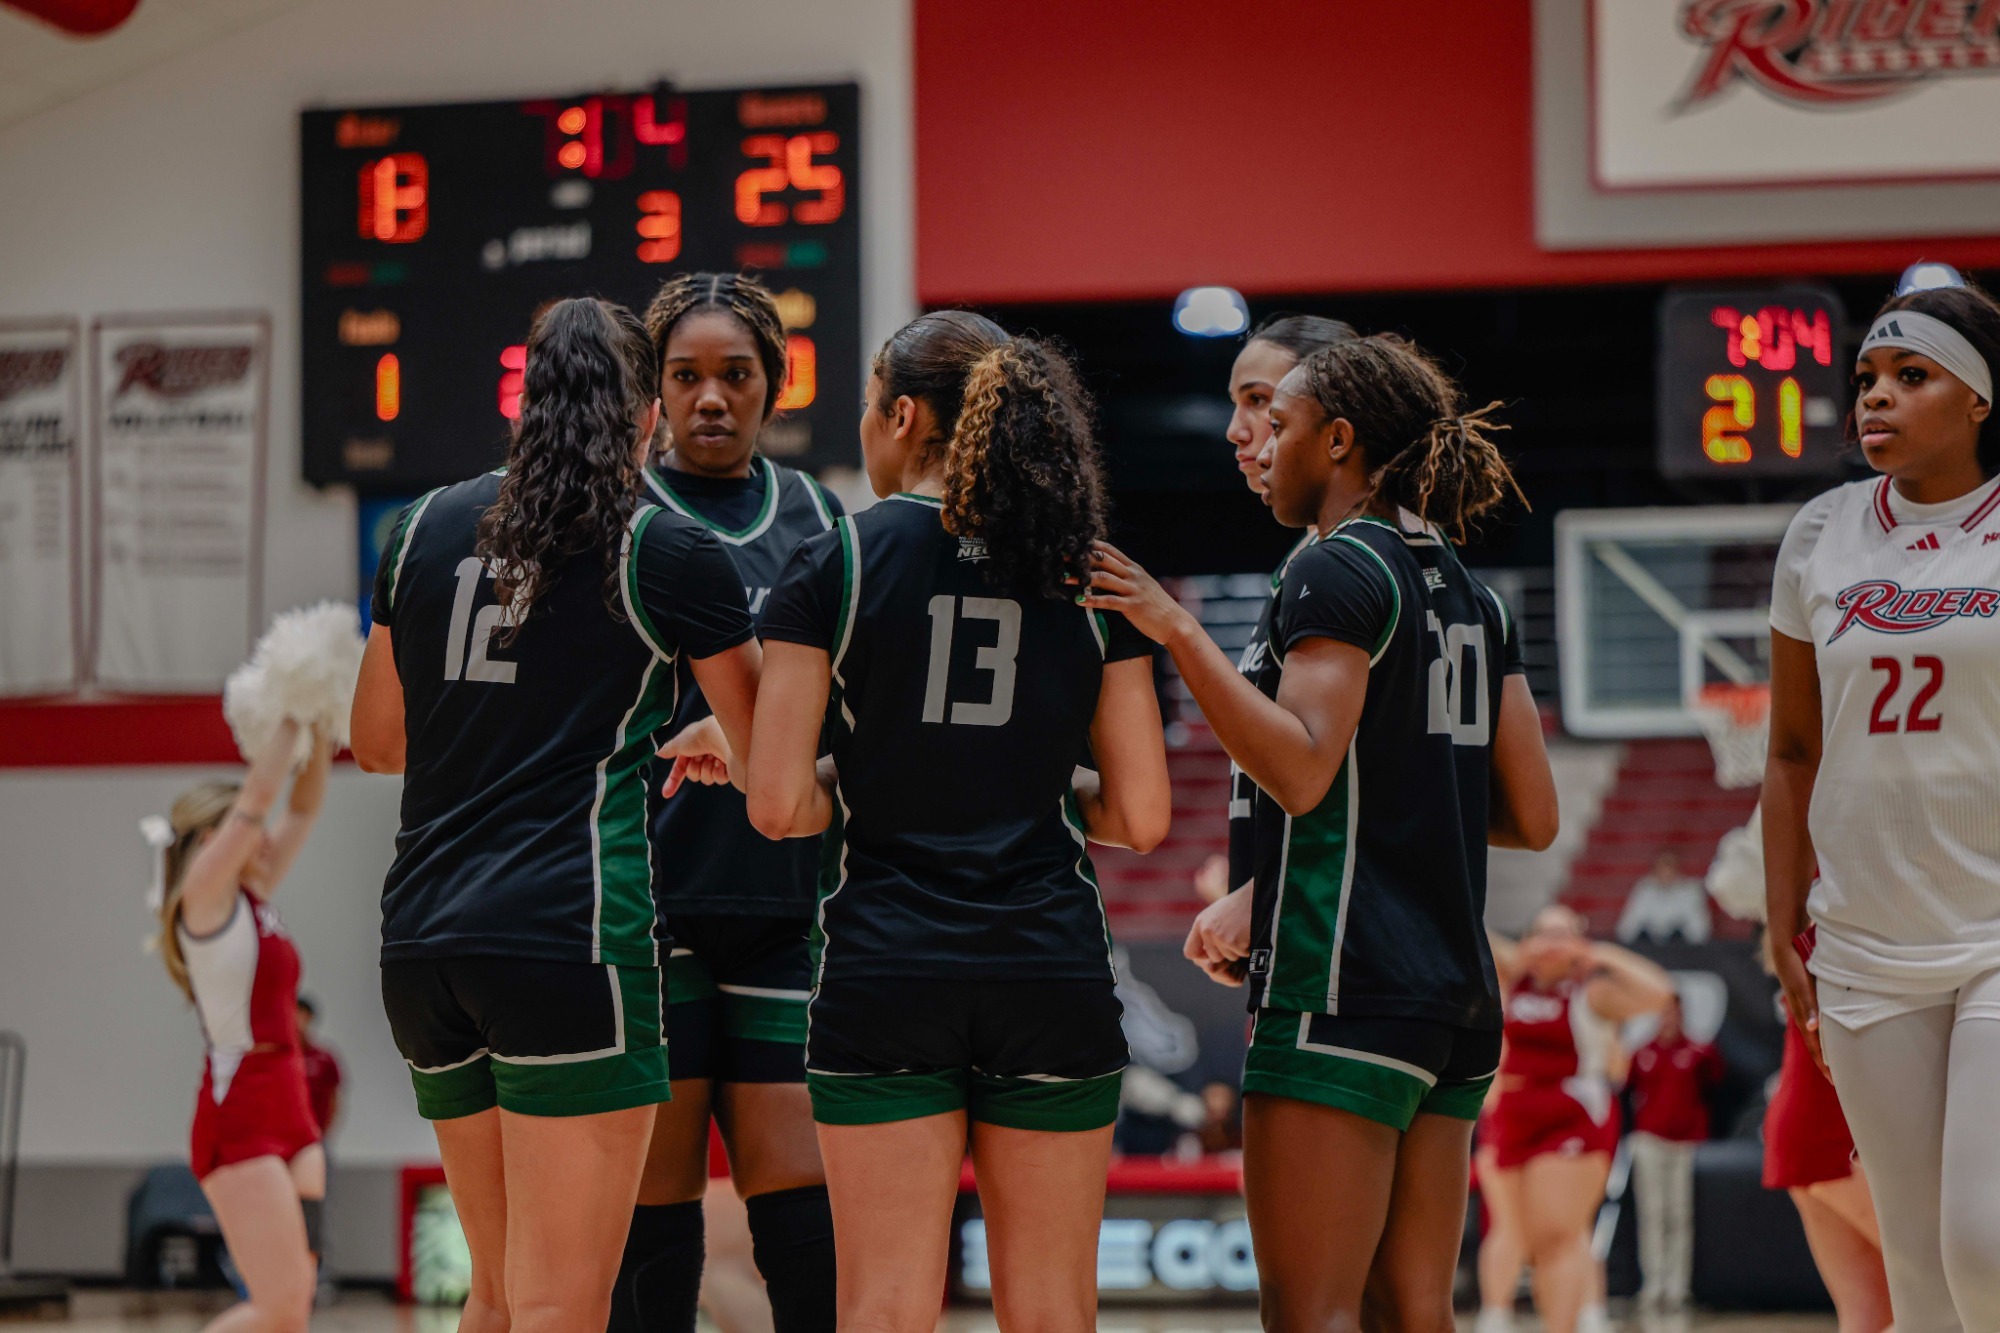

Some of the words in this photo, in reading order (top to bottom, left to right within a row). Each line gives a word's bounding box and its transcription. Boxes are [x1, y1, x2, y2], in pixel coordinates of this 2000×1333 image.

[735, 131, 846, 227] 25
[635, 190, 682, 263] 3
[1711, 305, 1832, 371] 7:04
[375, 353, 400, 422] 1
[1703, 375, 1802, 462] 21
[444, 556, 541, 684] 12
[1826, 579, 2000, 646] RIDER
[922, 594, 1023, 726] 13
[1426, 609, 1490, 746] 20
[1867, 654, 1945, 735] 22
